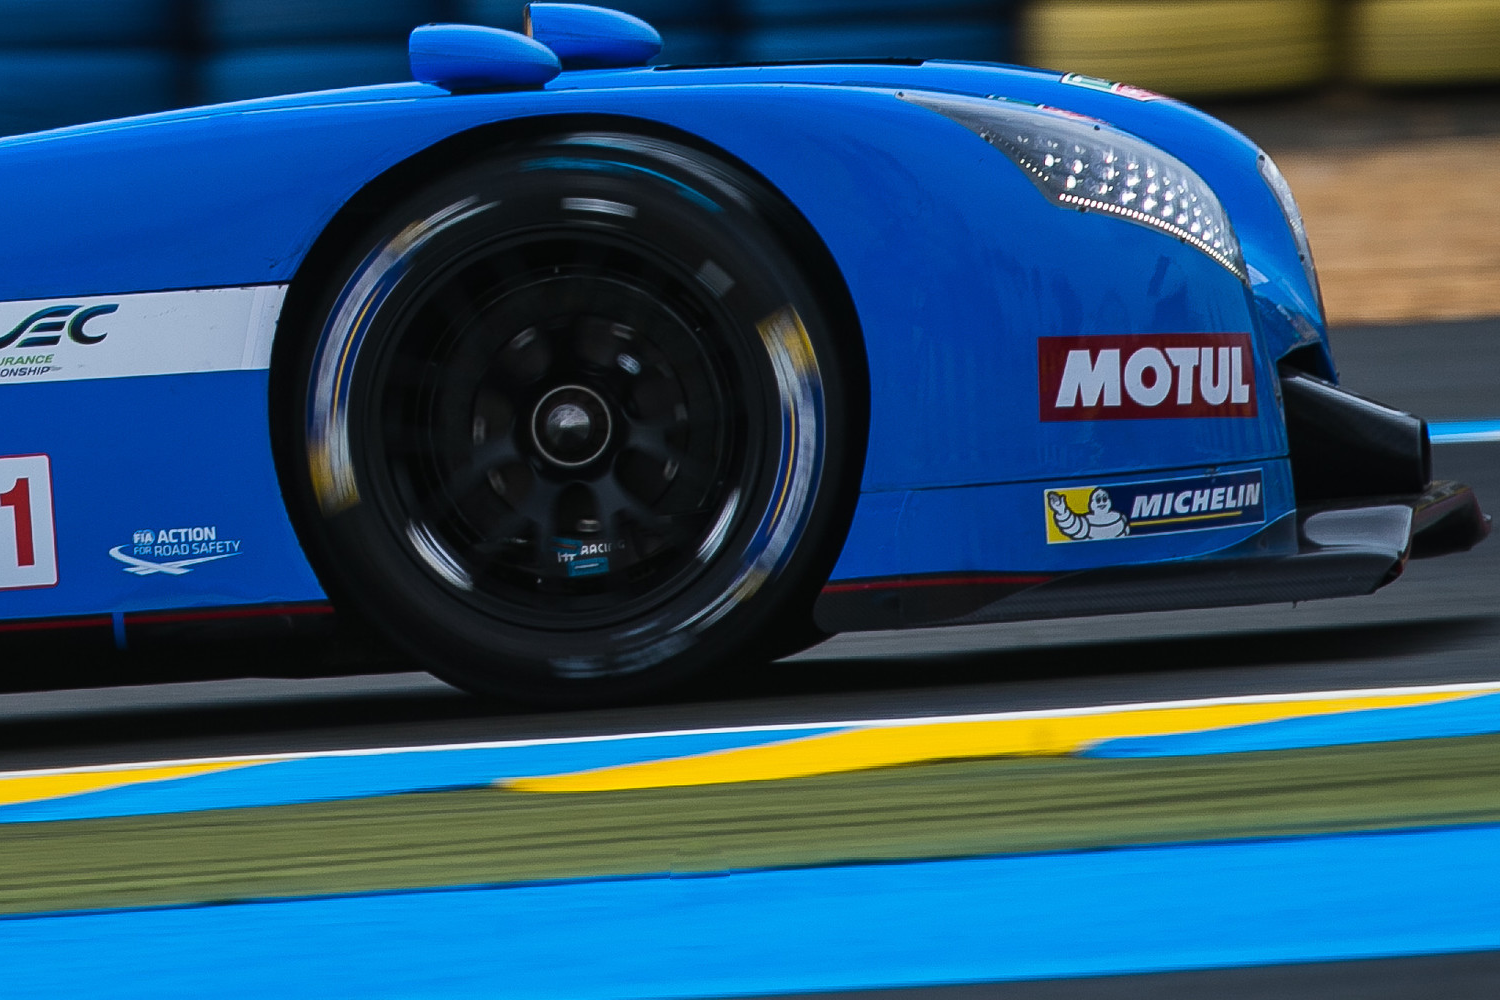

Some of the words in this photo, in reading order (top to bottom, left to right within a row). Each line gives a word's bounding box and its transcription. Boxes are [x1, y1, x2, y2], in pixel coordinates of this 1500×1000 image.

[1055, 346, 1250, 408] MOTUL
[1131, 481, 1262, 519] MICHELIN
[133, 545, 153, 556] FOR
[154, 543, 190, 558] ROAD
[191, 540, 241, 555] SAFETY
[157, 526, 216, 544] ACTION
